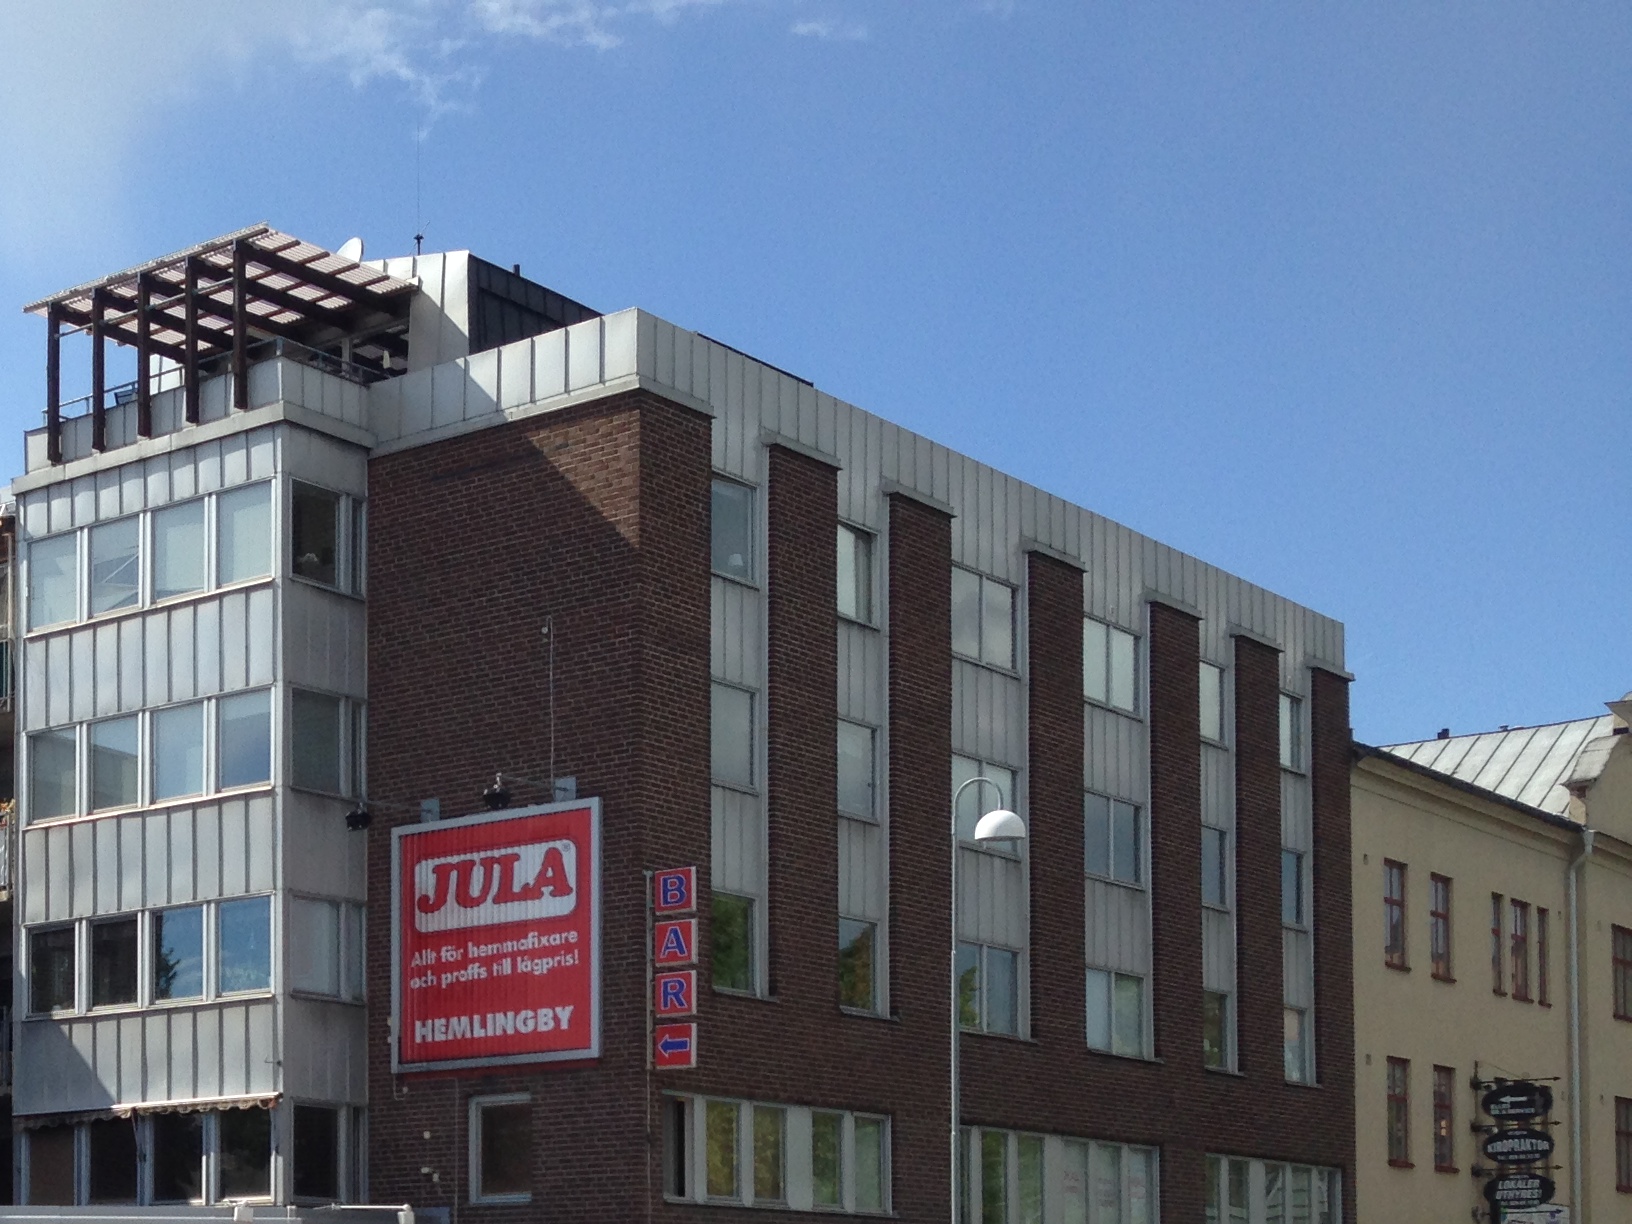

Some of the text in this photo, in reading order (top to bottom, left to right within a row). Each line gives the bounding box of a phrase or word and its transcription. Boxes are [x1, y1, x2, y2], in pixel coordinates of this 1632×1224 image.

[417, 847, 573, 913] JULA
[411, 931, 578, 967] Allt för hemmafixare
[660, 874, 689, 1010] BAR
[410, 949, 579, 989] och proffs till lågpris!
[415, 1005, 574, 1043] HEMLINGBY
